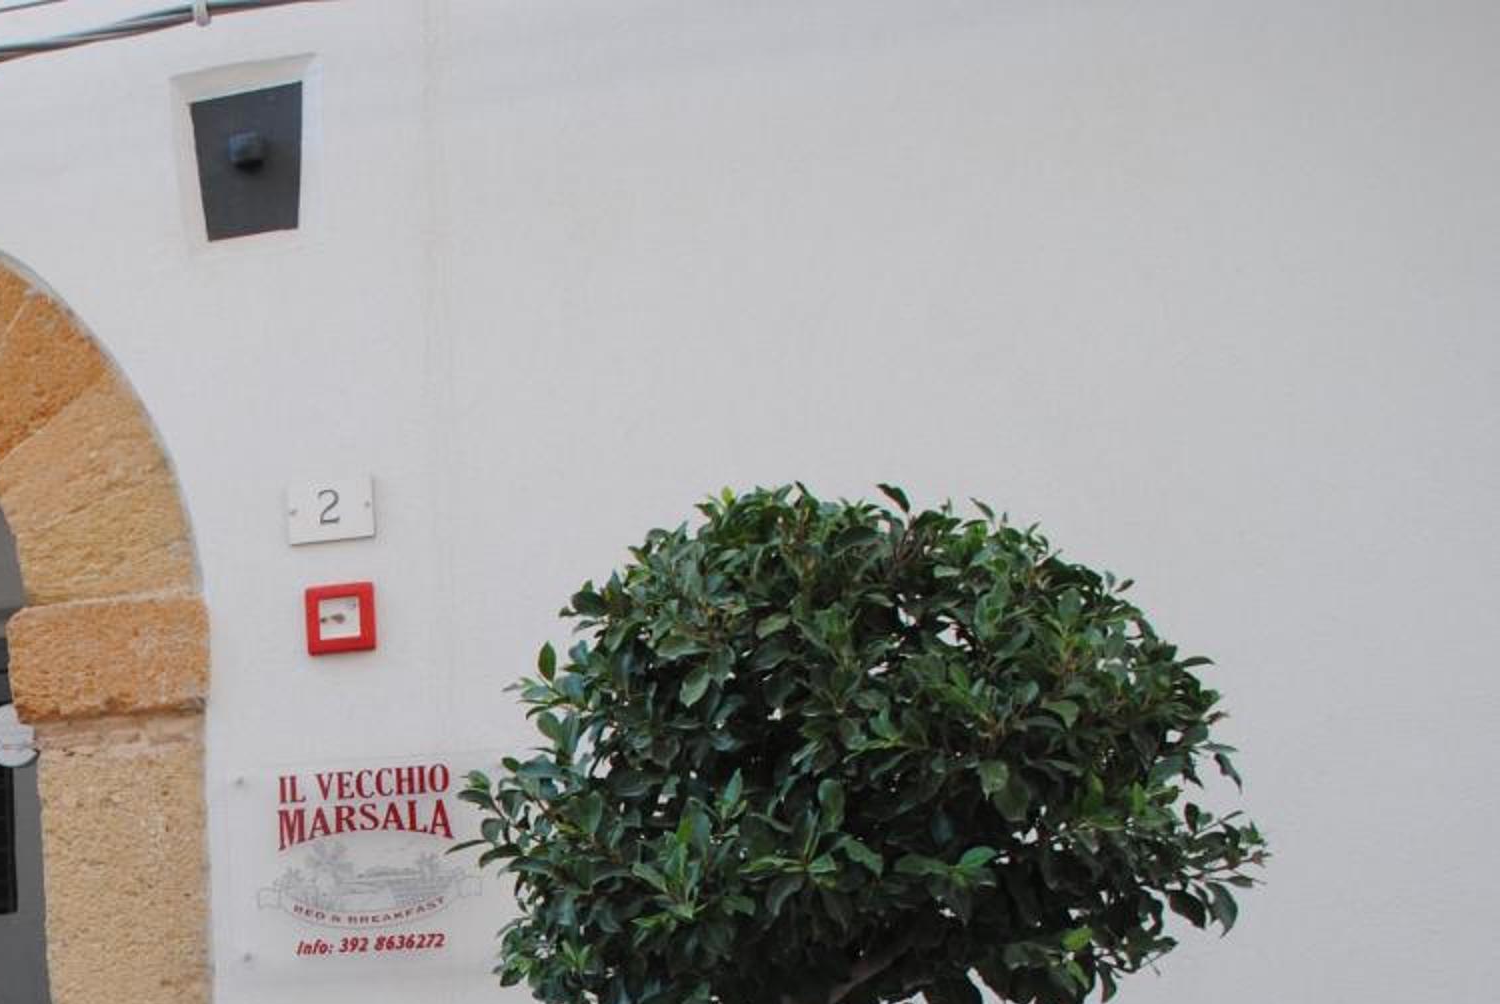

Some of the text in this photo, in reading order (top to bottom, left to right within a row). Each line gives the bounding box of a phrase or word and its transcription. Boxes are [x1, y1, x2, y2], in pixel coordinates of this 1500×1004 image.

[318, 489, 341, 525] 2
[279, 764, 449, 803] IL VECCHIO
[278, 799, 454, 850] MARSALA
[293, 904, 326, 919] BED
[348, 896, 445, 924] BREAKFAST
[296, 933, 446, 956] Info: 392 8636272
